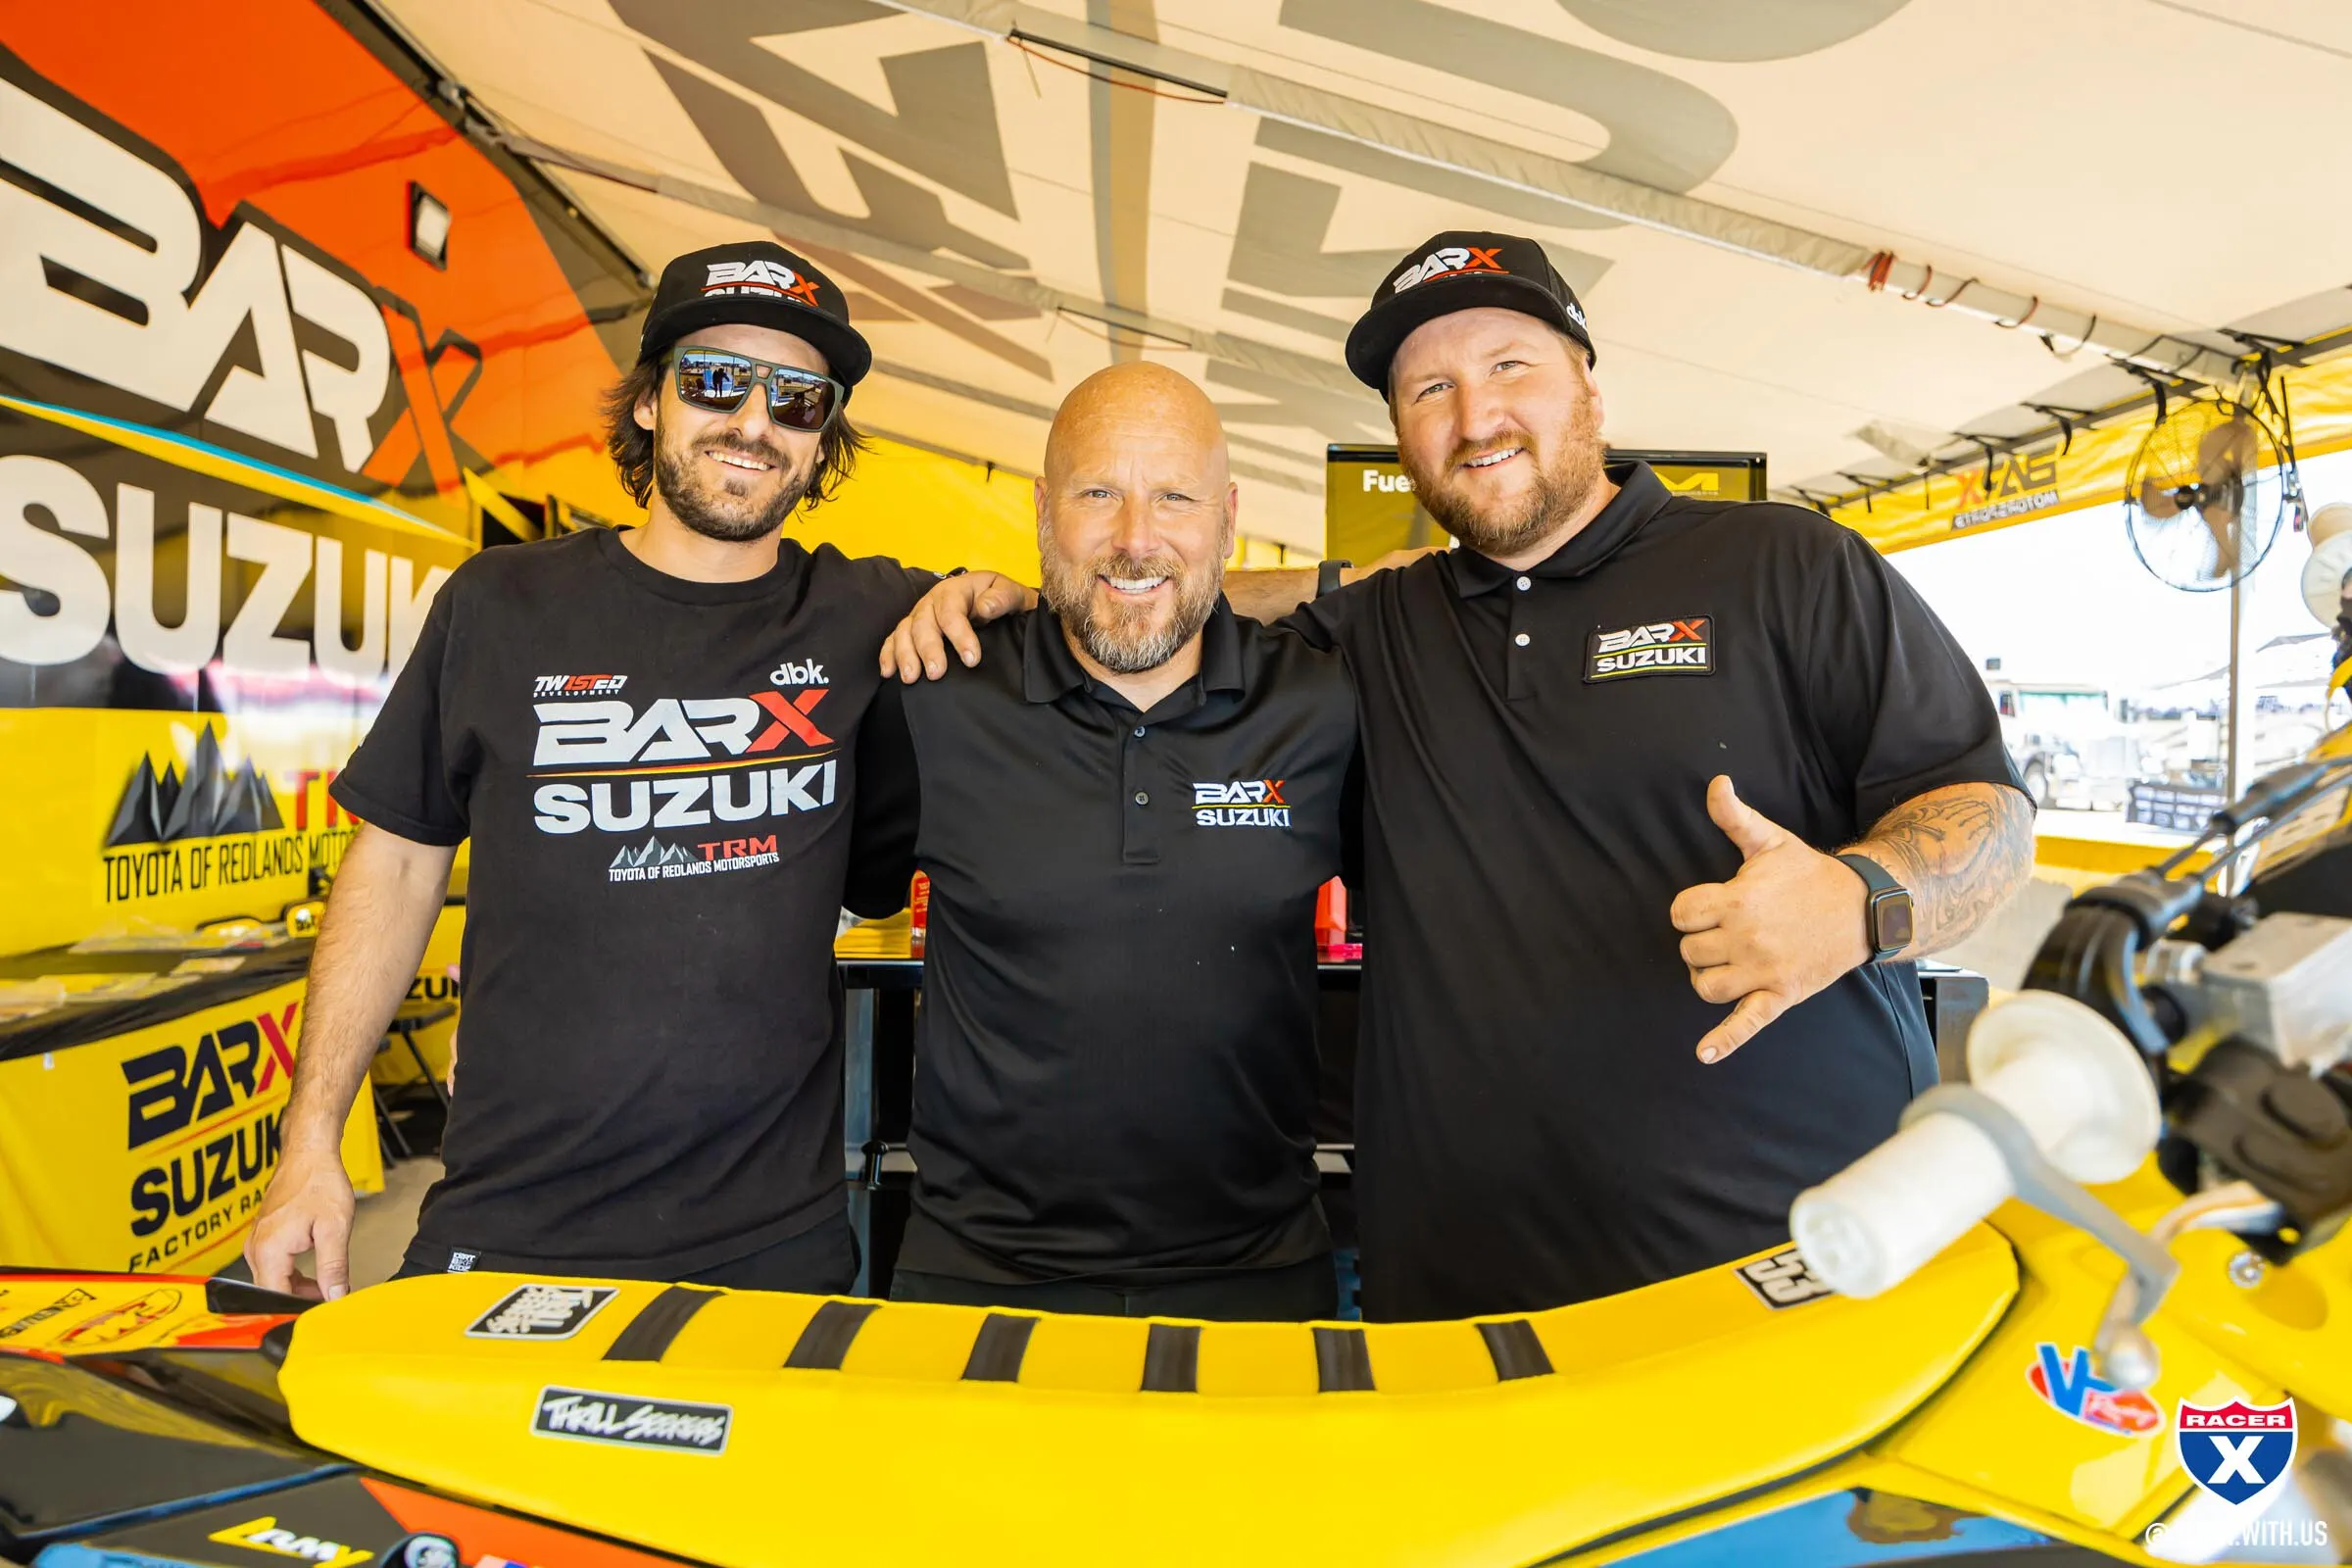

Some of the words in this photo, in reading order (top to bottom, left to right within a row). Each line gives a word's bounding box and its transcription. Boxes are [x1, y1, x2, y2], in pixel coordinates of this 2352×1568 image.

[0, 76, 482, 492] BARX
[705, 260, 820, 307] BARX
[1393, 247, 1502, 294] BARX
[1363, 469, 1417, 493] Fue
[0, 454, 455, 688] SUZUK
[1596, 647, 1706, 672] SUZUKI
[1597, 619, 1706, 654] BARX
[533, 689, 619, 698] DEVELOPMENT
[533, 689, 834, 766] BARX
[534, 760, 837, 834] SUZUKI
[1193, 779, 1286, 804] BARX
[1196, 808, 1292, 826] SUZUKI
[103, 848, 182, 903] TOYOTA
[190, 846, 213, 890] OF
[219, 835, 303, 886] REDLANDS
[609, 867, 646, 882] TOYOTA
[648, 865, 661, 880] OF
[662, 860, 711, 879] REDLANDS
[713, 852, 780, 872] MOTORSPORTS
[697, 834, 777, 861] TRM
[121, 1001, 299, 1152] BARX
[130, 1105, 286, 1238] SUZUK
[128, 1204, 233, 1274] FACTORY
